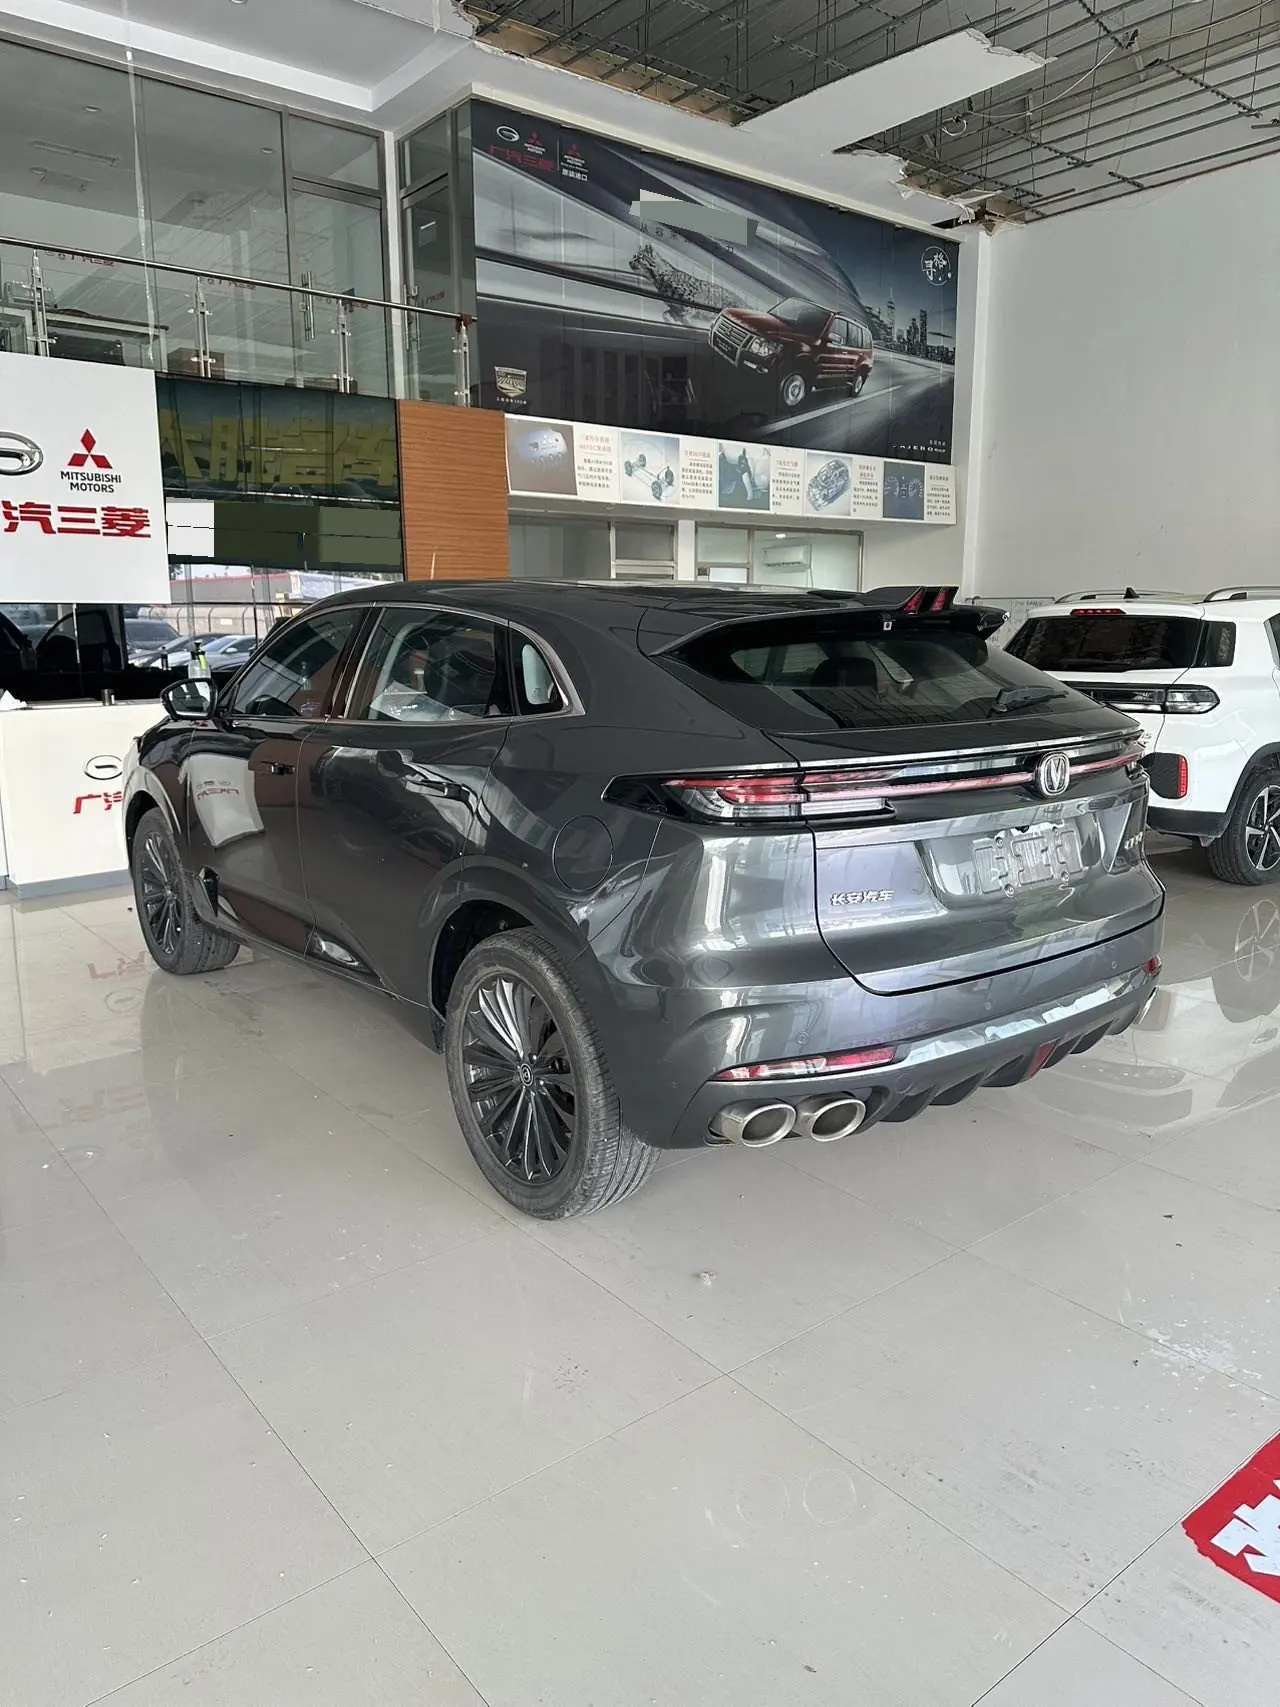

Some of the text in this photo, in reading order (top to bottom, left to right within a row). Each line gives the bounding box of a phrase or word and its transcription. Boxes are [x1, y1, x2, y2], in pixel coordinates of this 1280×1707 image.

[60, 470, 122, 483] MITSUBISHI
[69, 482, 115, 494] MOTORS
[831, 889, 894, 906] 长安汽车
